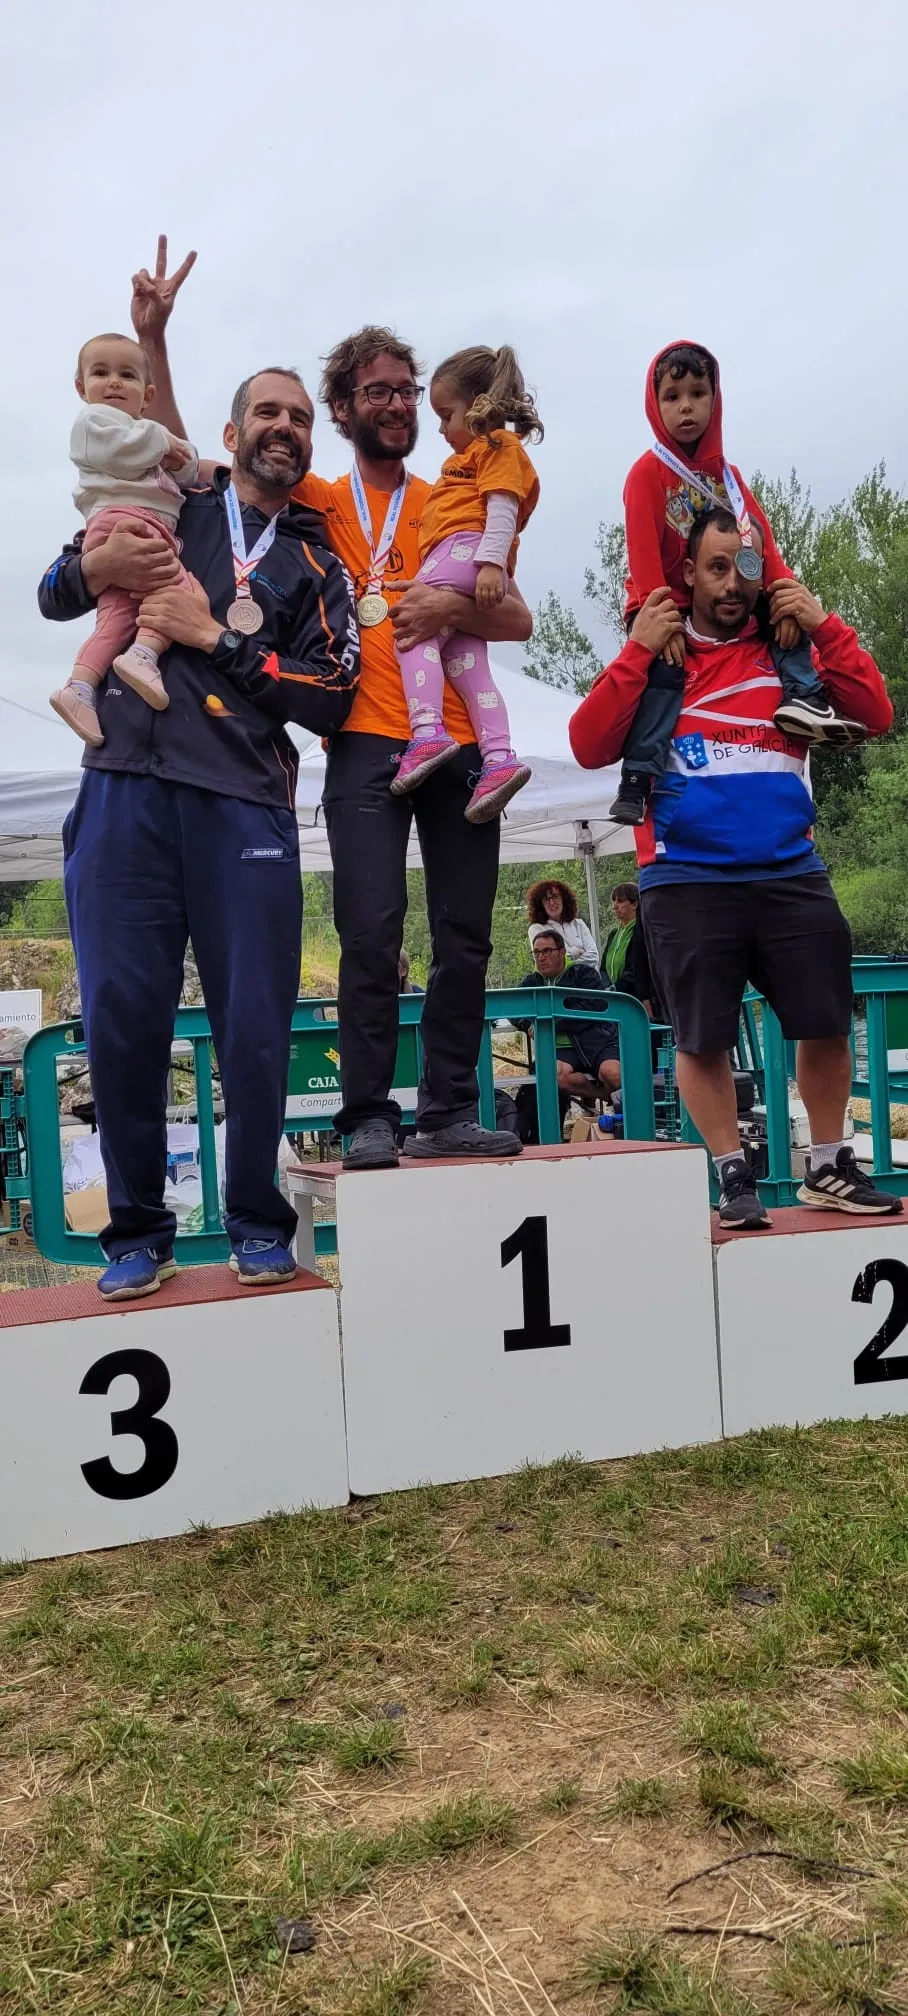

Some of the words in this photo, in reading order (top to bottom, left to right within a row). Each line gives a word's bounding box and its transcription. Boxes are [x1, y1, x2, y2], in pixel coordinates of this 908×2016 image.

[712, 724, 767, 746] XUNTA
[713, 746, 734, 760] DE
[739, 739, 794, 753] GALICIA
[308, 1076, 339, 1089] CAJA
[501, 1215, 571, 1352] 1
[851, 1258, 908, 1385] 2
[78, 1348, 179, 1500] 3
